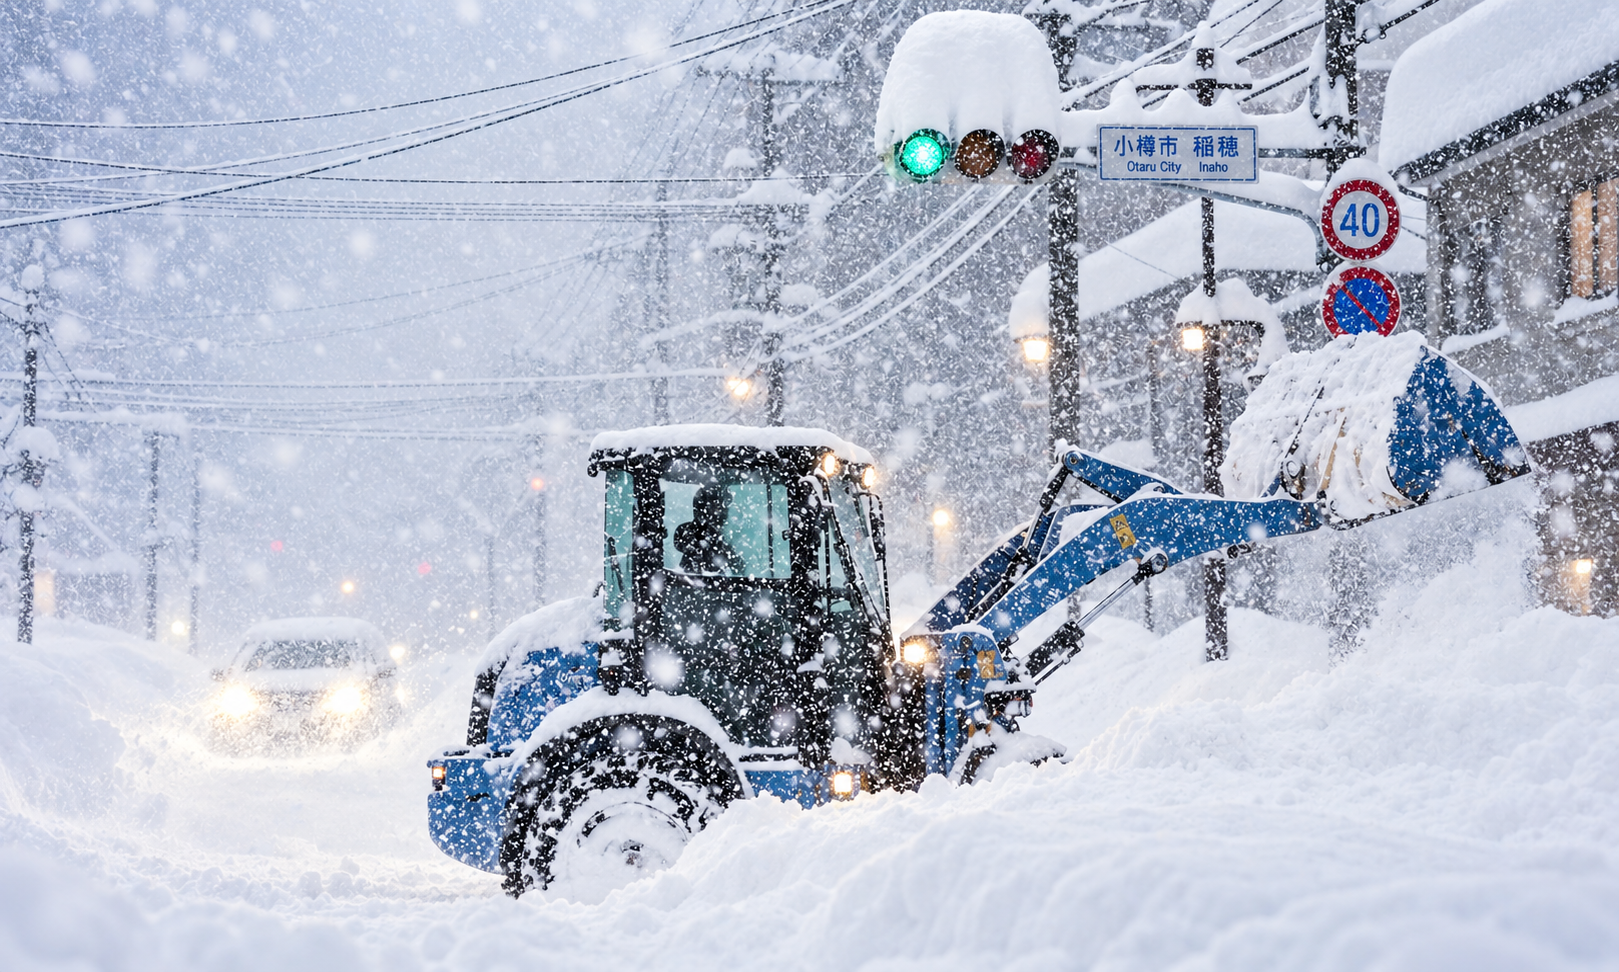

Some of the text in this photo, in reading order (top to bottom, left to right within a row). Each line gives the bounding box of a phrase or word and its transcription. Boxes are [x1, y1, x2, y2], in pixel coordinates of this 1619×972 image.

[1113, 134, 1239, 157] 小樽市 稲穂
[1127, 160, 1229, 174] Otaru City Inaho
[1340, 203, 1379, 237] 40
